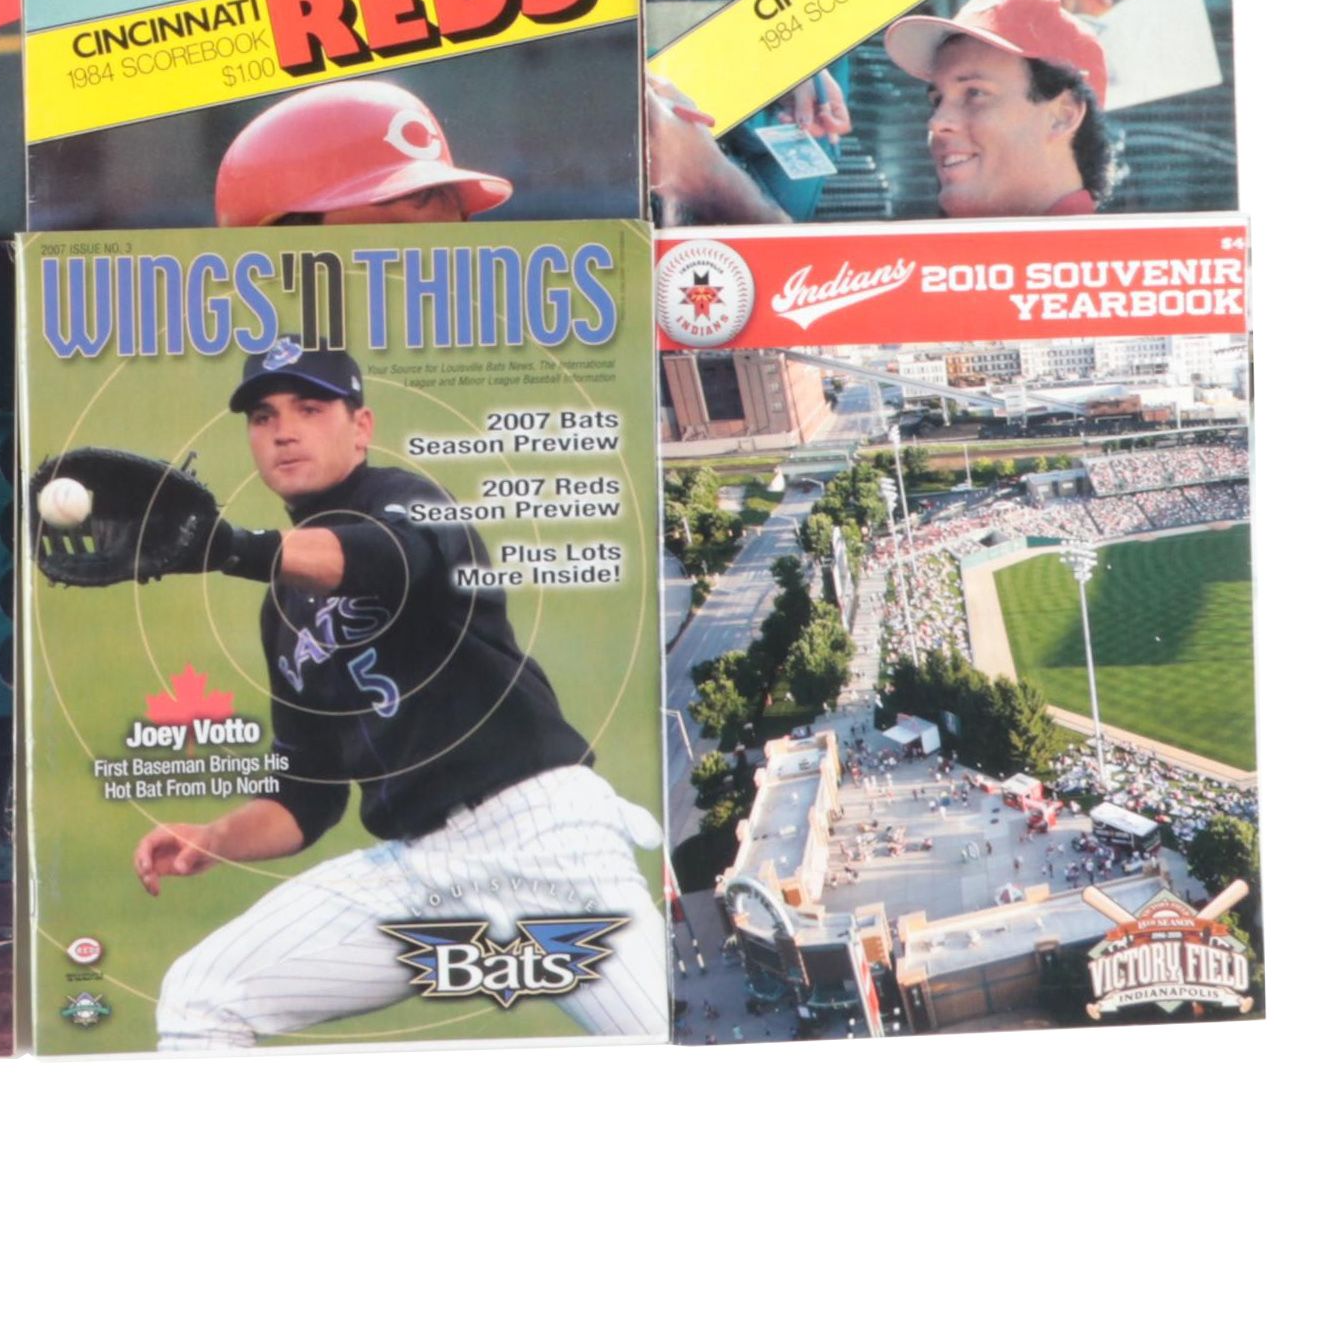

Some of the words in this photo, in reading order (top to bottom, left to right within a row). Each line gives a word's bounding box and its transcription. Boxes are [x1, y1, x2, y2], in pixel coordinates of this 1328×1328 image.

[760, 14, 804, 51] 1984
[67, 62, 115, 89] 1984
[122, 29, 271, 78] SCOREBOOK
[222, 57, 276, 87] $1.00
[41, 245, 66, 255] 2007
[70, 244, 100, 255] ISSUE
[103, 244, 121, 254] NO.
[126, 243, 132, 253] 3
[773, 258, 916, 313] Indians
[921, 264, 1013, 292] 2010
[1026, 258, 1242, 290] SOUVENIR
[41, 250, 279, 358] WINGS
[352, 243, 617, 350] THINGS
[1010, 290, 1242, 320] YEARBOOK
[676, 314, 728, 336] INDIANS
[391, 363, 422, 374] Source
[486, 361, 506, 370] Bats
[523, 373, 559, 384] Baseball
[487, 413, 551, 430] 2007
[560, 411, 619, 429] Bats
[408, 437, 503, 455] Season
[514, 433, 619, 452] Preview
[482, 479, 546, 498] 2007
[555, 476, 620, 496] Reds
[410, 503, 505, 522] Season
[514, 499, 620, 518] Preview
[500, 544, 558, 564] Plus
[566, 543, 621, 562] Lots
[456, 568, 524, 587] More
[533, 564, 620, 585] Inside!
[347, 646, 399, 717] 5
[126, 722, 186, 750] Joey
[193, 719, 260, 744] Votto
[95, 760, 128, 777] First
[133, 758, 205, 776] Baseman
[210, 756, 260, 774] Brings
[264, 754, 289, 771] His
[105, 782, 131, 799] Hot
[136, 781, 162, 797] Bat
[167, 779, 206, 796] From
[211, 779, 232, 797] Up
[236, 777, 280, 794] North
[436, 944, 573, 991] Bats
[1088, 942, 1184, 998] VICTORY
[1184, 943, 1249, 992] FIELD
[1119, 988, 1219, 1001] INDIANAPOLIS
